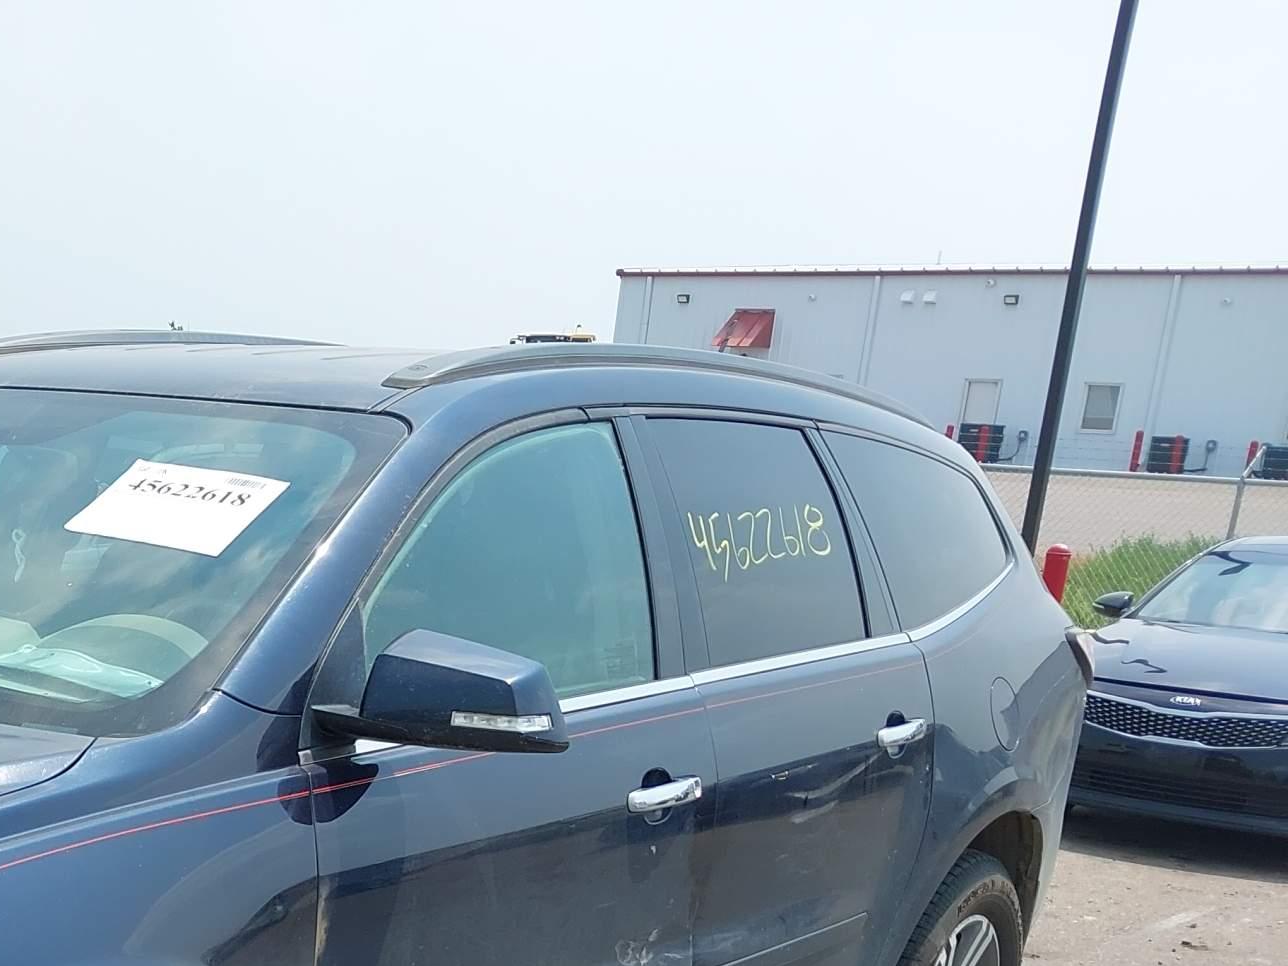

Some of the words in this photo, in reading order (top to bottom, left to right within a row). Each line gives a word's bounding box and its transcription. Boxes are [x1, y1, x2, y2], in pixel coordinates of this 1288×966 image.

[128, 477, 252, 507] 45622618
[687, 503, 832, 583] 45622618
[1174, 695, 1202, 706] KIA
